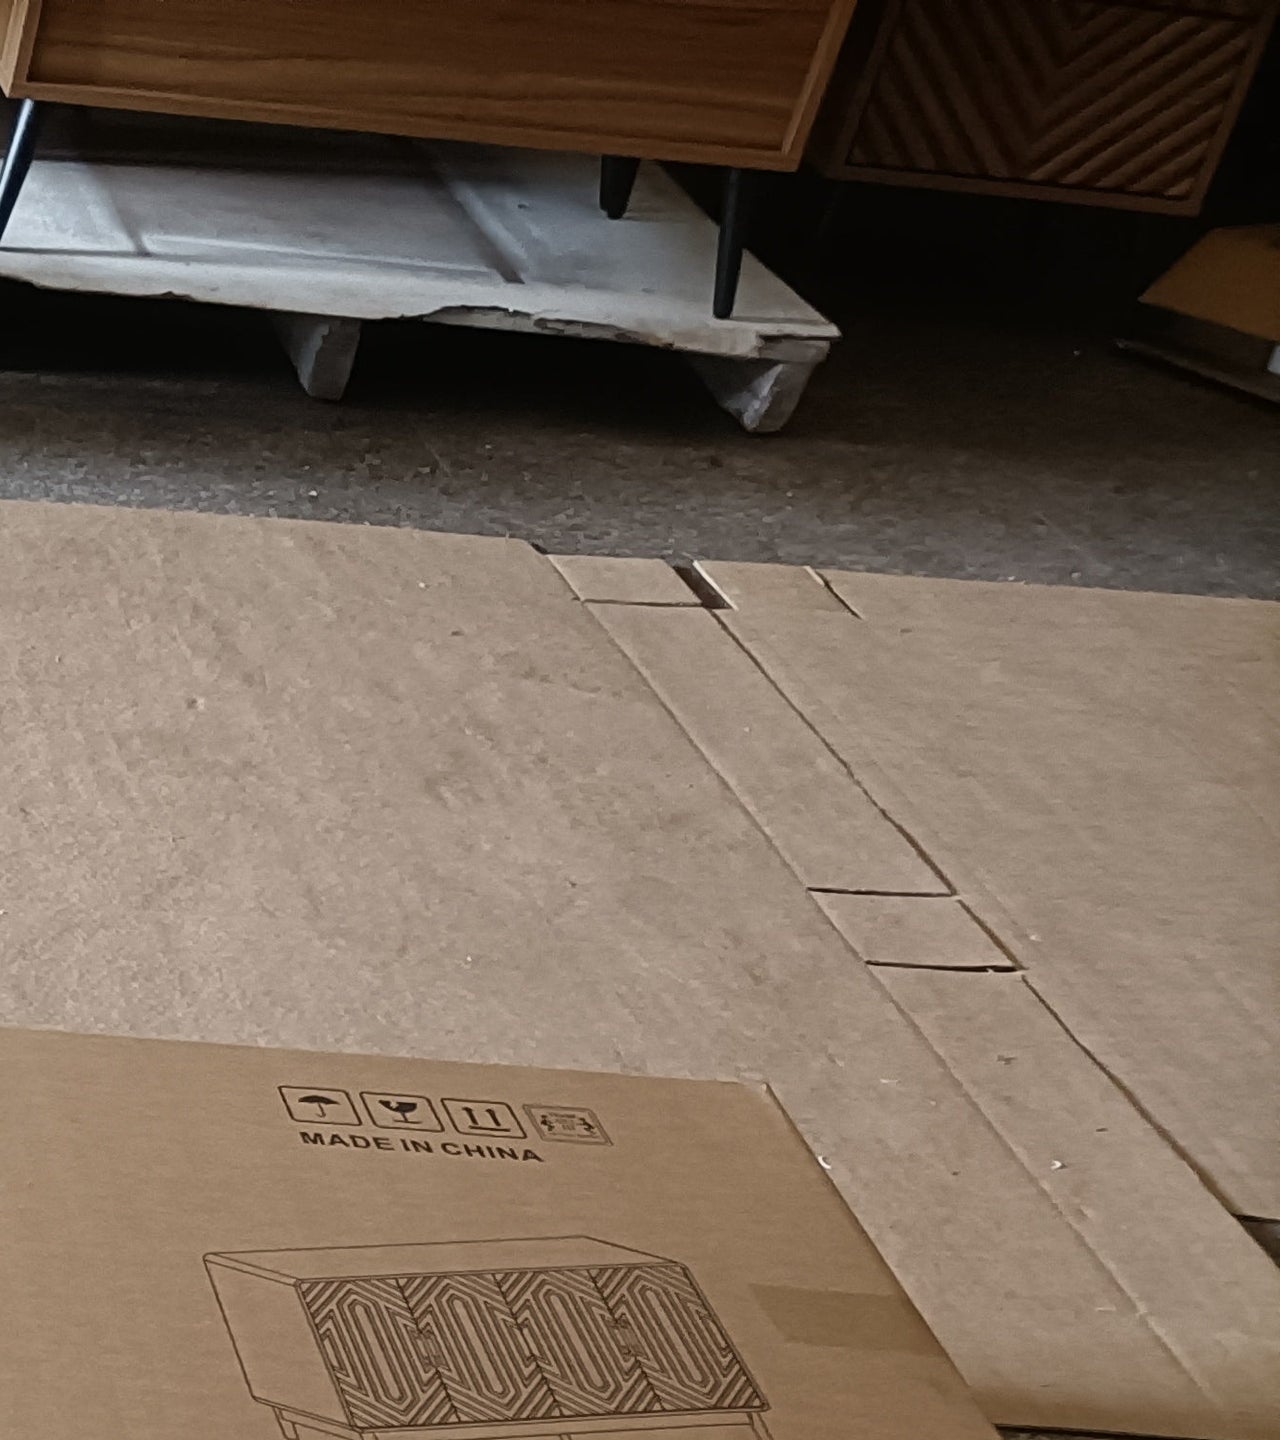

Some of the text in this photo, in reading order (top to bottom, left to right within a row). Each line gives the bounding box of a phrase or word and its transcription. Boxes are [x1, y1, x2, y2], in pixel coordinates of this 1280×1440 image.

[298, 1131, 545, 1163] MADE IN CHINA
